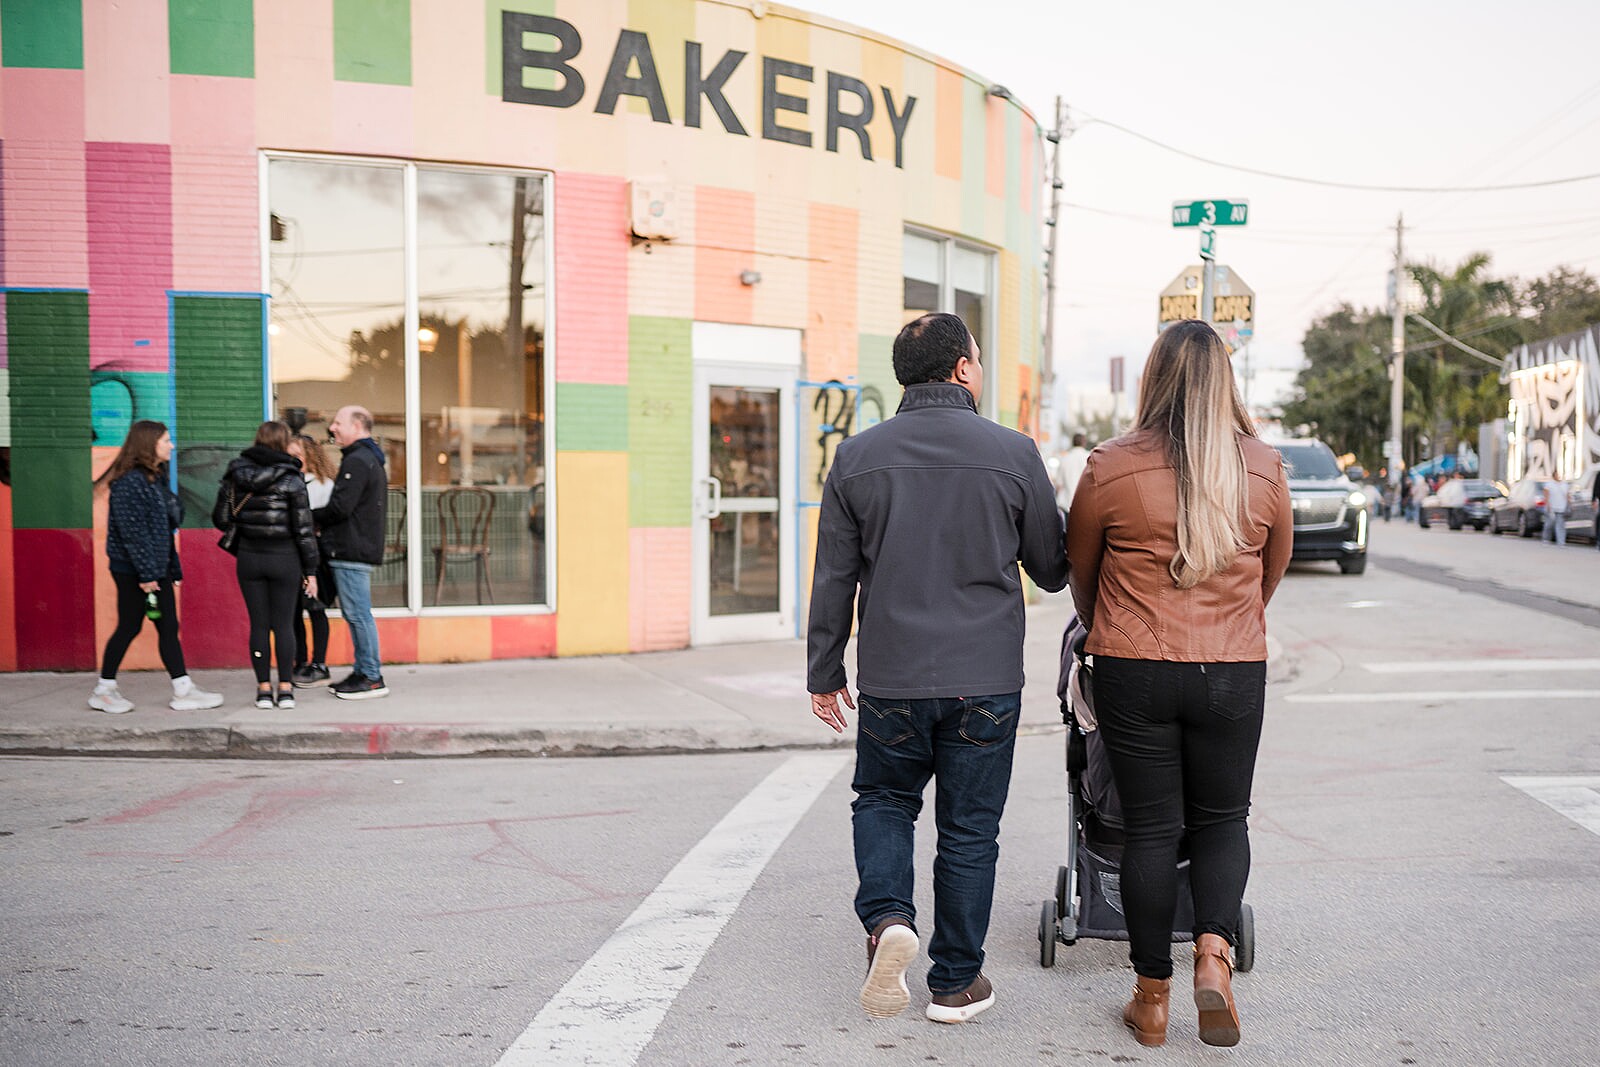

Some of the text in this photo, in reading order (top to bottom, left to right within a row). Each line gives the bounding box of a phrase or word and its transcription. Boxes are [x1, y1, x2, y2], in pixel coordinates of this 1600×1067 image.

[502, 10, 918, 169] BAKERY
[1173, 200, 1246, 225] NW 3 AV
